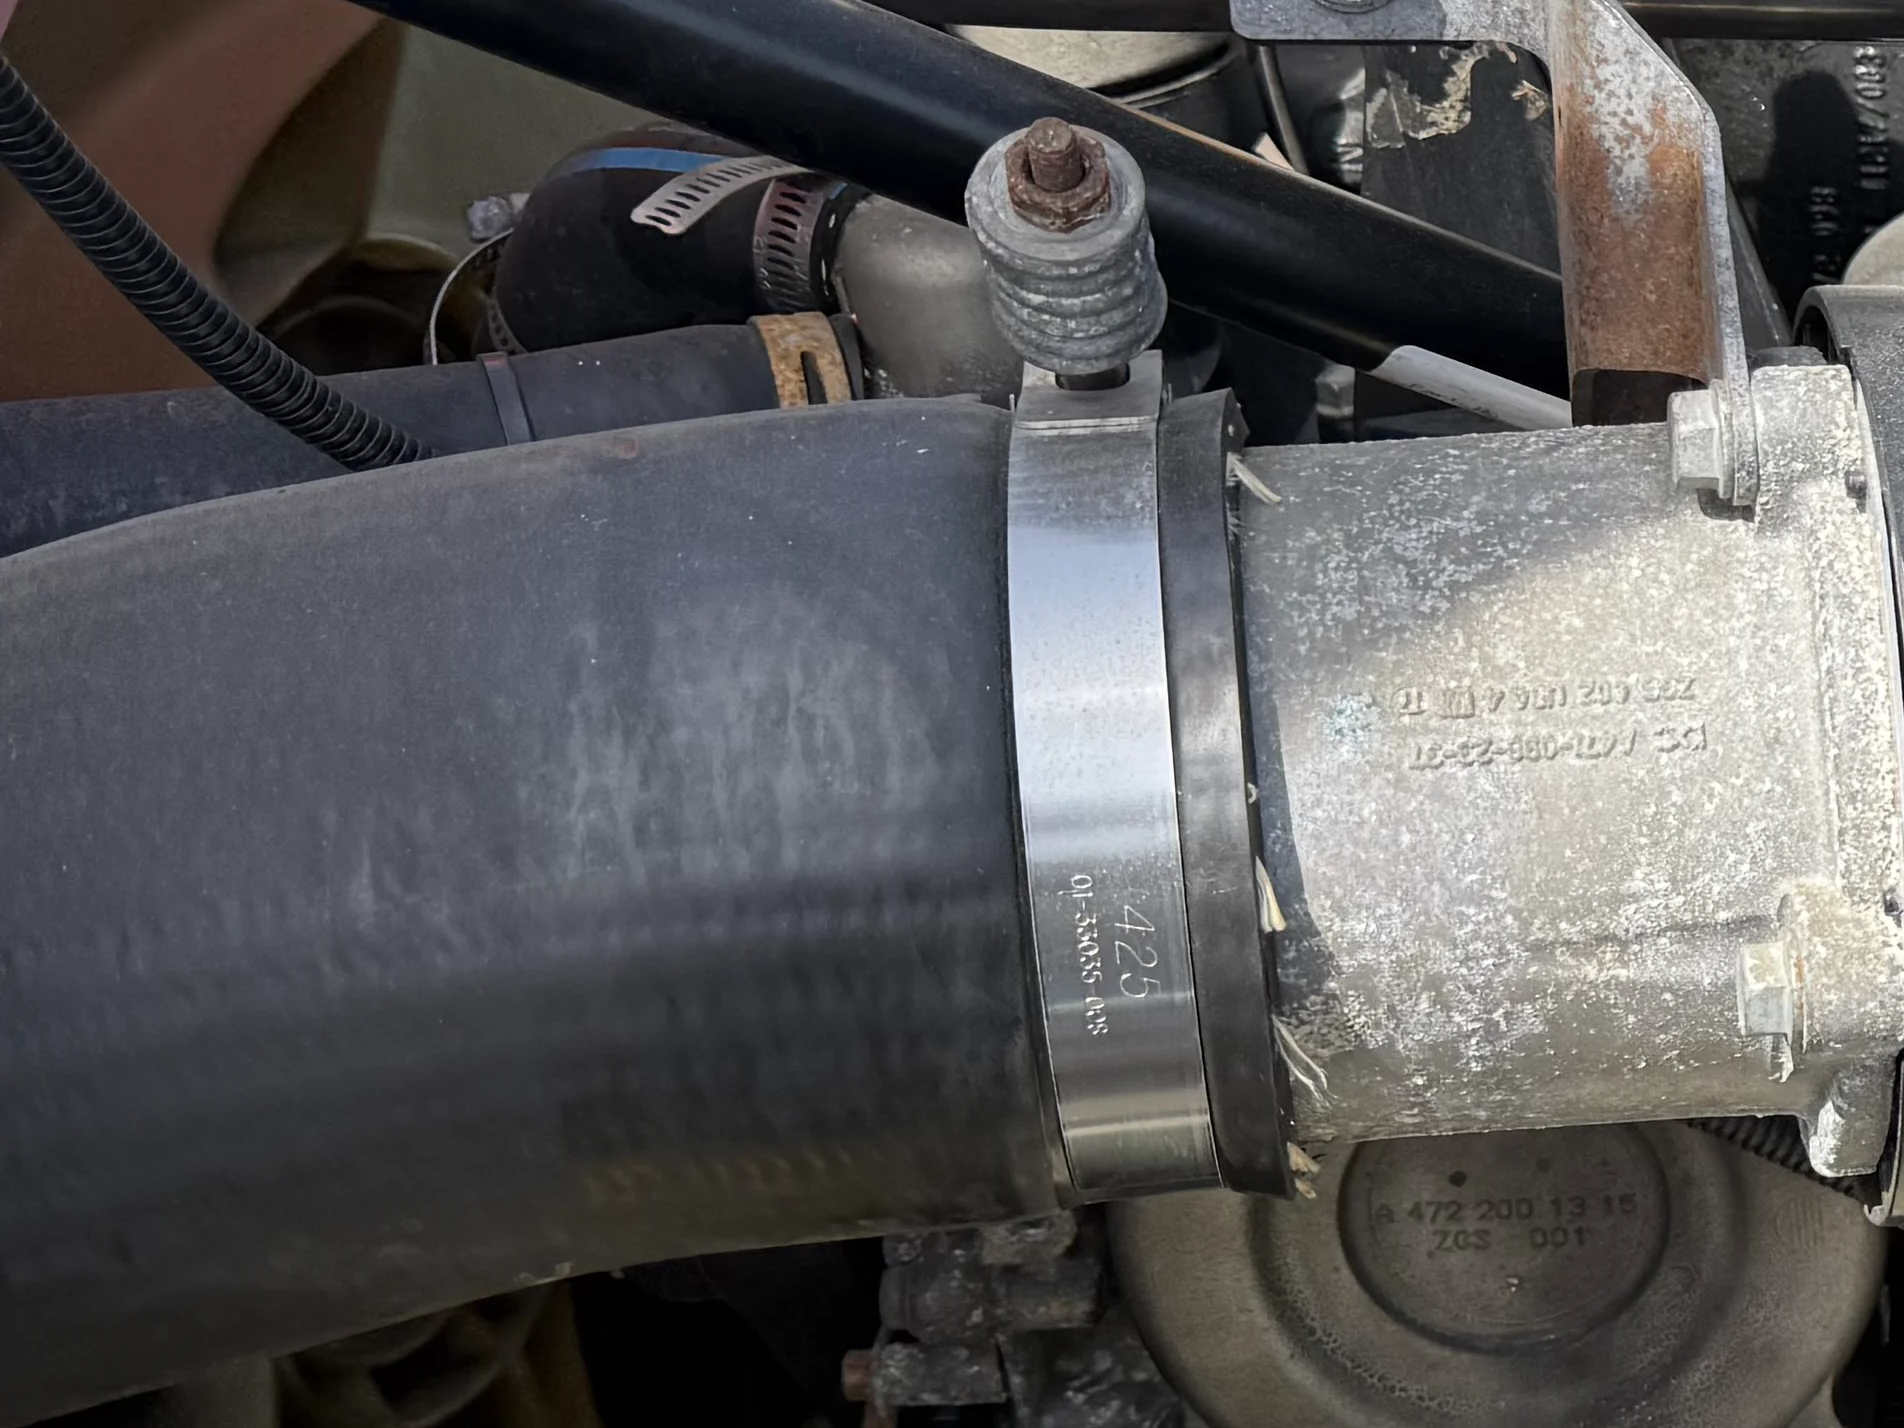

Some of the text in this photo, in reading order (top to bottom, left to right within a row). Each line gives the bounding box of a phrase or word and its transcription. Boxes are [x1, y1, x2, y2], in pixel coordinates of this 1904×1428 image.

[1113, 902, 1160, 1000] 425
[1407, 1200, 1462, 1222] 472
[1476, 1197, 1534, 1220] 200
[1549, 1195, 1586, 1218] 13
[1528, 1225, 1587, 1249] 001
